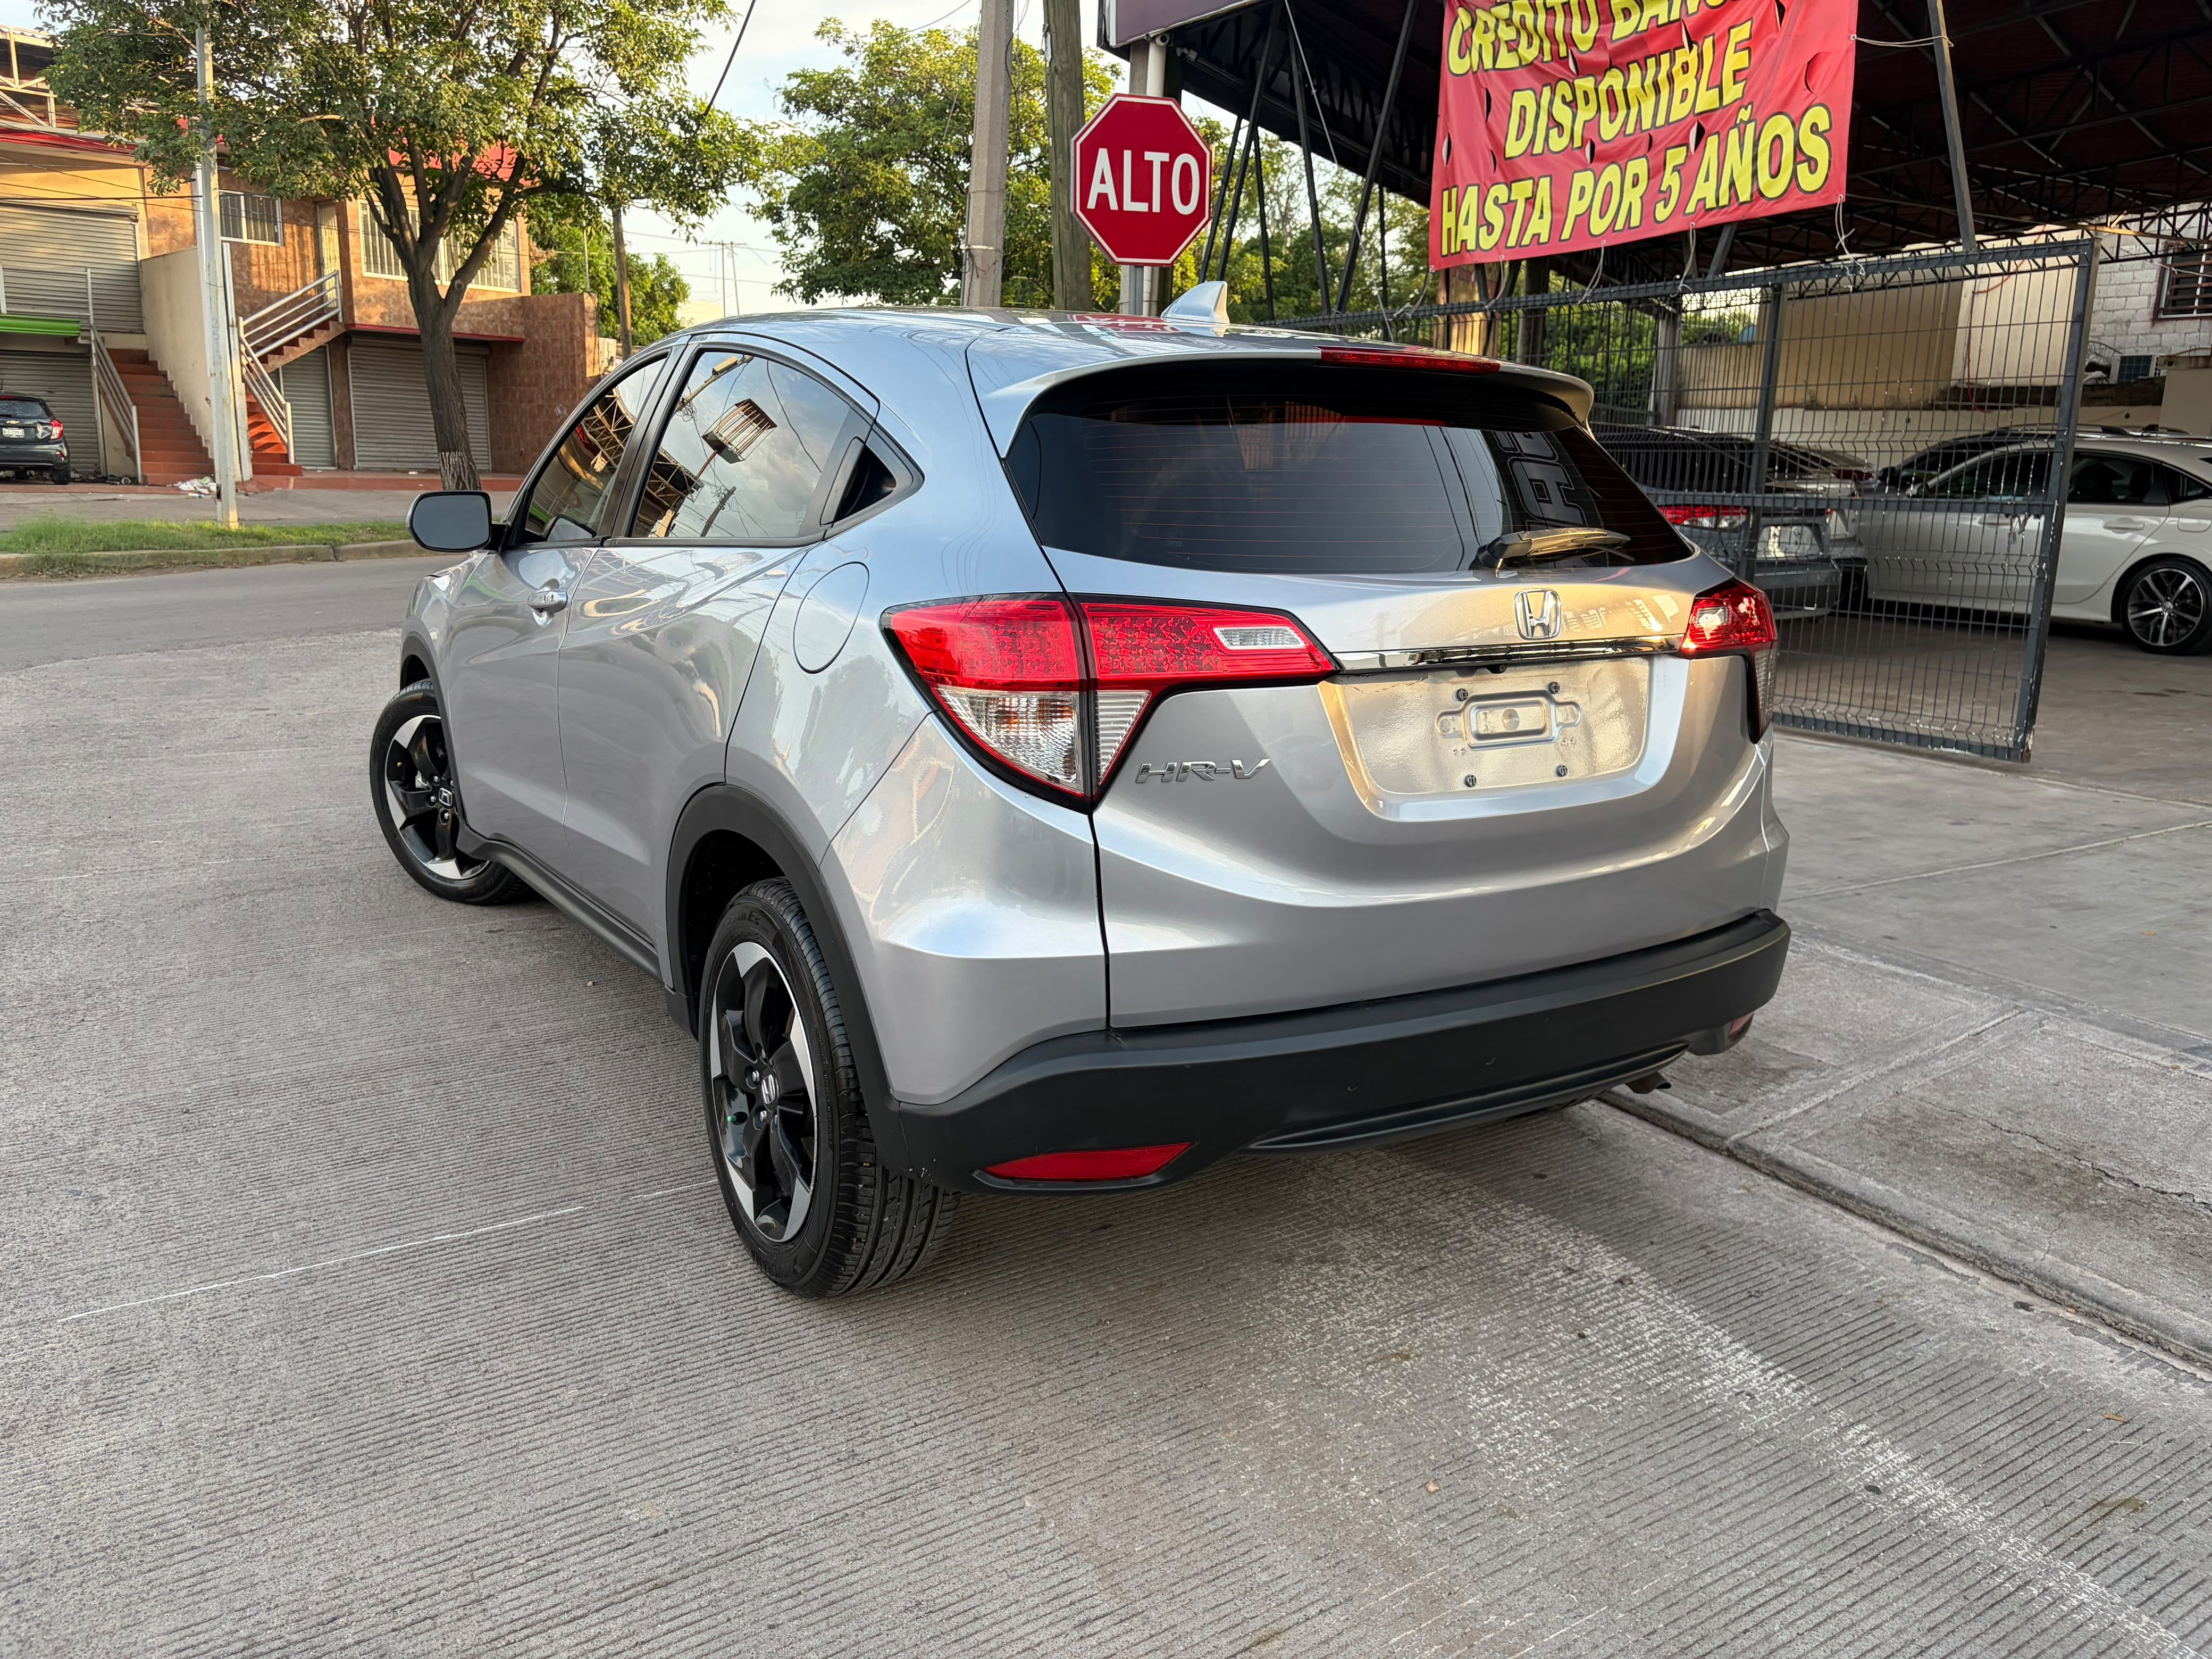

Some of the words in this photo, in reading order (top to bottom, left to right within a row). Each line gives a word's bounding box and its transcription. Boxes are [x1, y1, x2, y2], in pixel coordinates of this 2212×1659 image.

[1505, 19, 1753, 160] DISPONIBLE
[1087, 148, 1200, 215] ALTO
[1440, 174, 1552, 258] HASTA
[1559, 154, 1650, 242] POR
[1654, 143, 1689, 223] 5
[1683, 102, 1833, 216] AÑOS
[1135, 758, 1271, 784] HR-V
